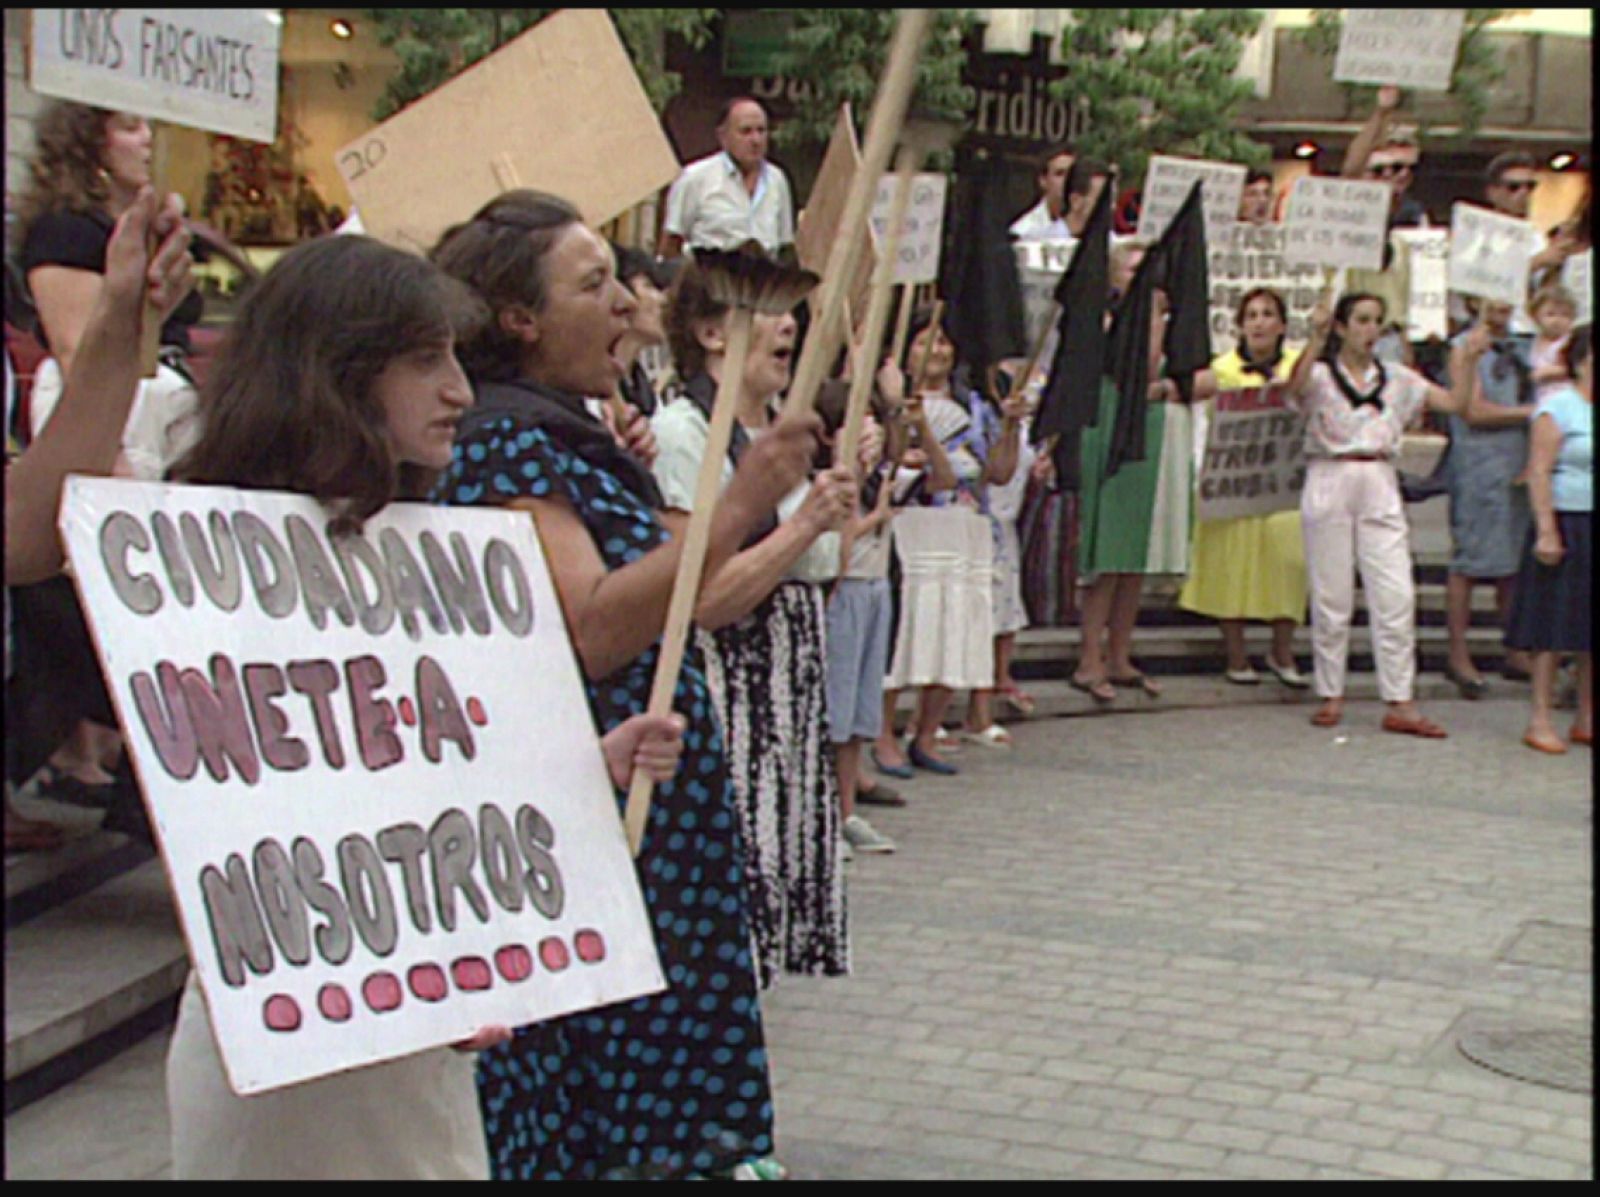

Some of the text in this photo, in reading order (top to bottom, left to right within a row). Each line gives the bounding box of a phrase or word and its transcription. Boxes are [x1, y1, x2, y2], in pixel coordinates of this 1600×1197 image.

[138, 15, 254, 100] FARSANTES
[951, 72, 1091, 143] eridion
[340, 138, 387, 180] 20
[99, 510, 533, 641] CIUDADANO
[198, 803, 564, 987] NOSOTROS
